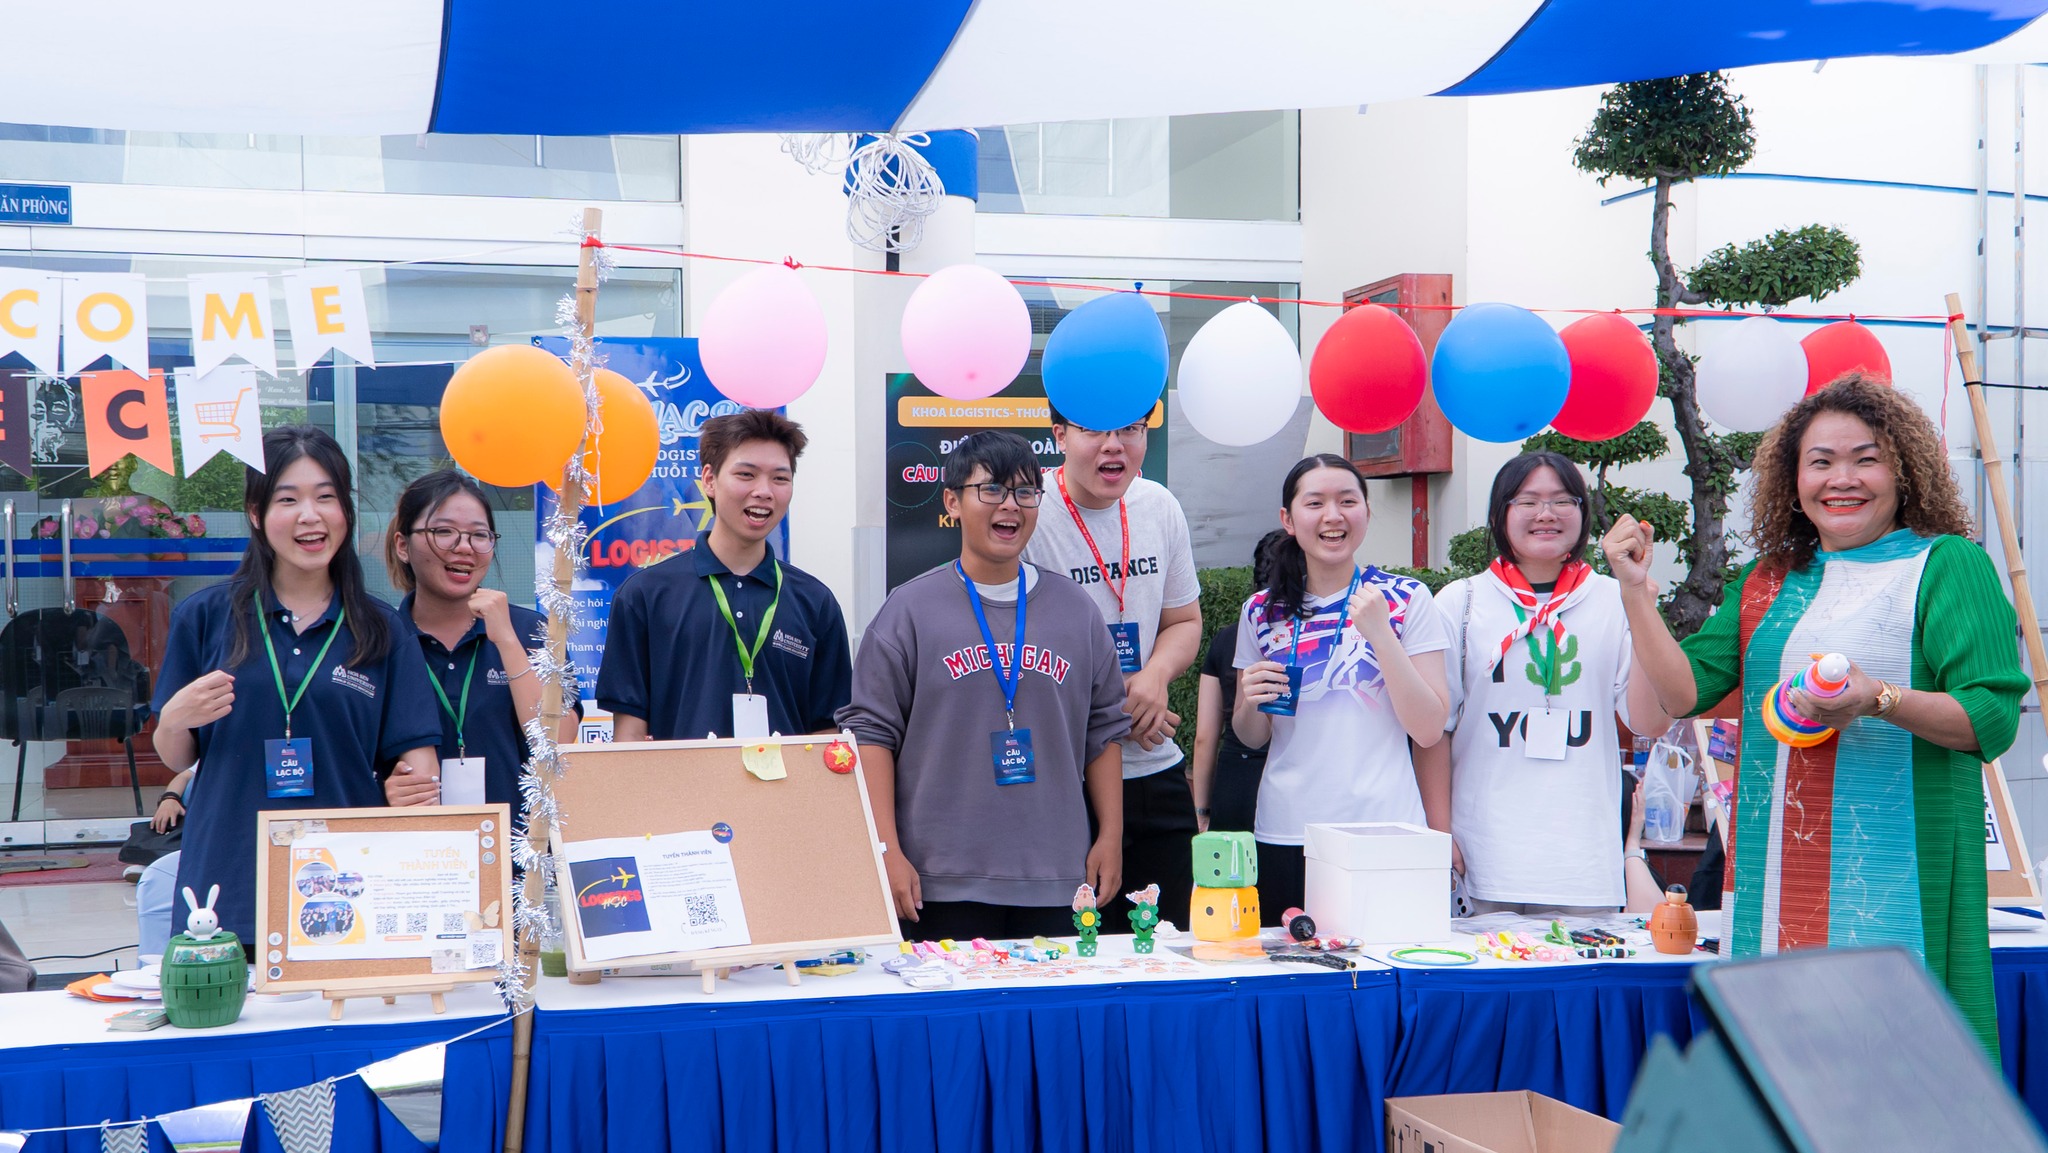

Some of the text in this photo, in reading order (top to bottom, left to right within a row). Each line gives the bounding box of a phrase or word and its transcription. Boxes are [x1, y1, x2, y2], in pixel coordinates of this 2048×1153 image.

[22, 195, 68, 215] PHÒNG
[912, 407, 947, 418] KHOA
[903, 463, 939, 483] CÂU
[1487, 710, 1592, 748] YU
[1006, 749, 1021, 757] CÂU
[281, 758, 298, 767] CÂU
[1001, 756, 1027, 767] LẠC BỘ
[275, 767, 305, 778] LẠC BỘ
